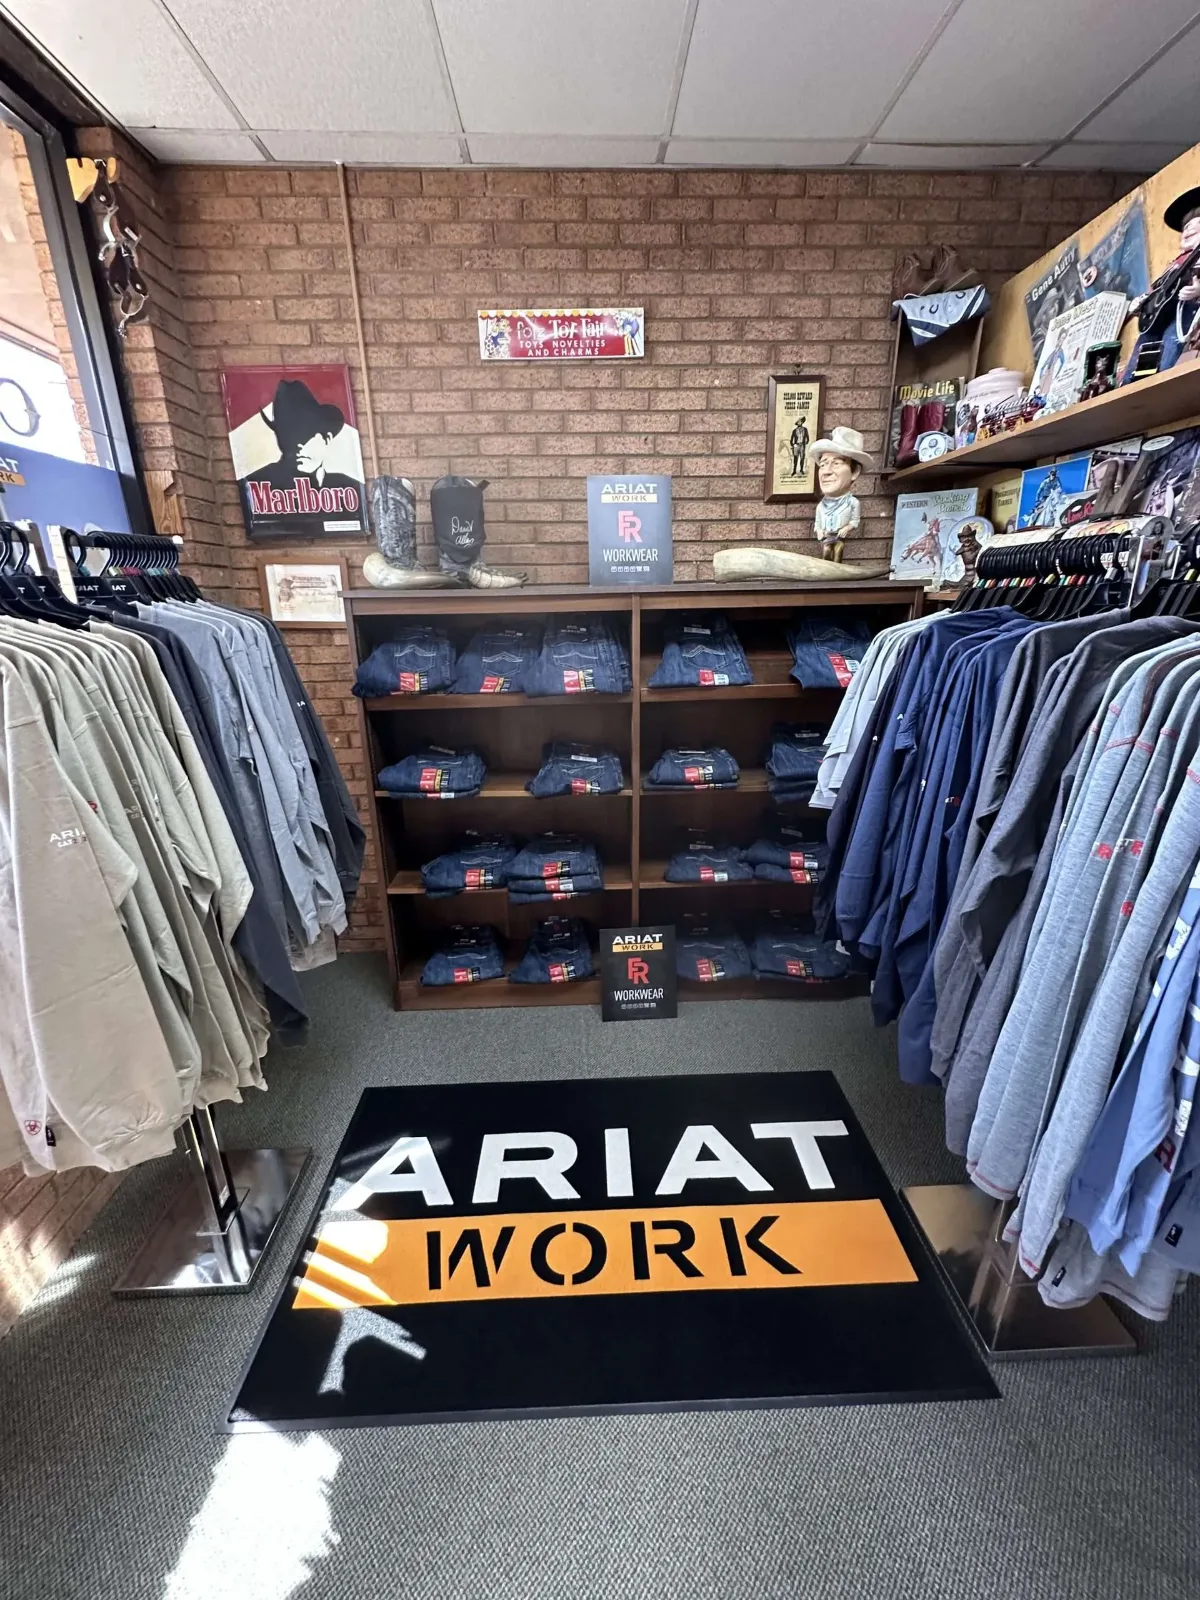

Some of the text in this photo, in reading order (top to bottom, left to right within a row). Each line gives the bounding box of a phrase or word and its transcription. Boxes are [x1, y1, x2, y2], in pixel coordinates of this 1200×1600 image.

[1031, 247, 1076, 301] Gene Autry
[519, 339, 606, 349] TOYS NOVELTIES
[527, 348, 600, 357] AND CHARMS
[900, 385, 933, 400] Movie
[935, 380, 955, 396] Life
[248, 477, 359, 514] Marlboro
[600, 483, 658, 494] ARIAT
[901, 499, 929, 509] WESTERN
[618, 510, 643, 543] FR
[603, 548, 659, 562] WORKWEAR
[49, 828, 86, 843] ARI
[612, 933, 663, 945] ARIAT
[627, 957, 650, 985] FR
[614, 988, 664, 1002] WORKWEAR
[333, 1119, 848, 1210] ARIAT
[426, 1214, 803, 1291] WORK
